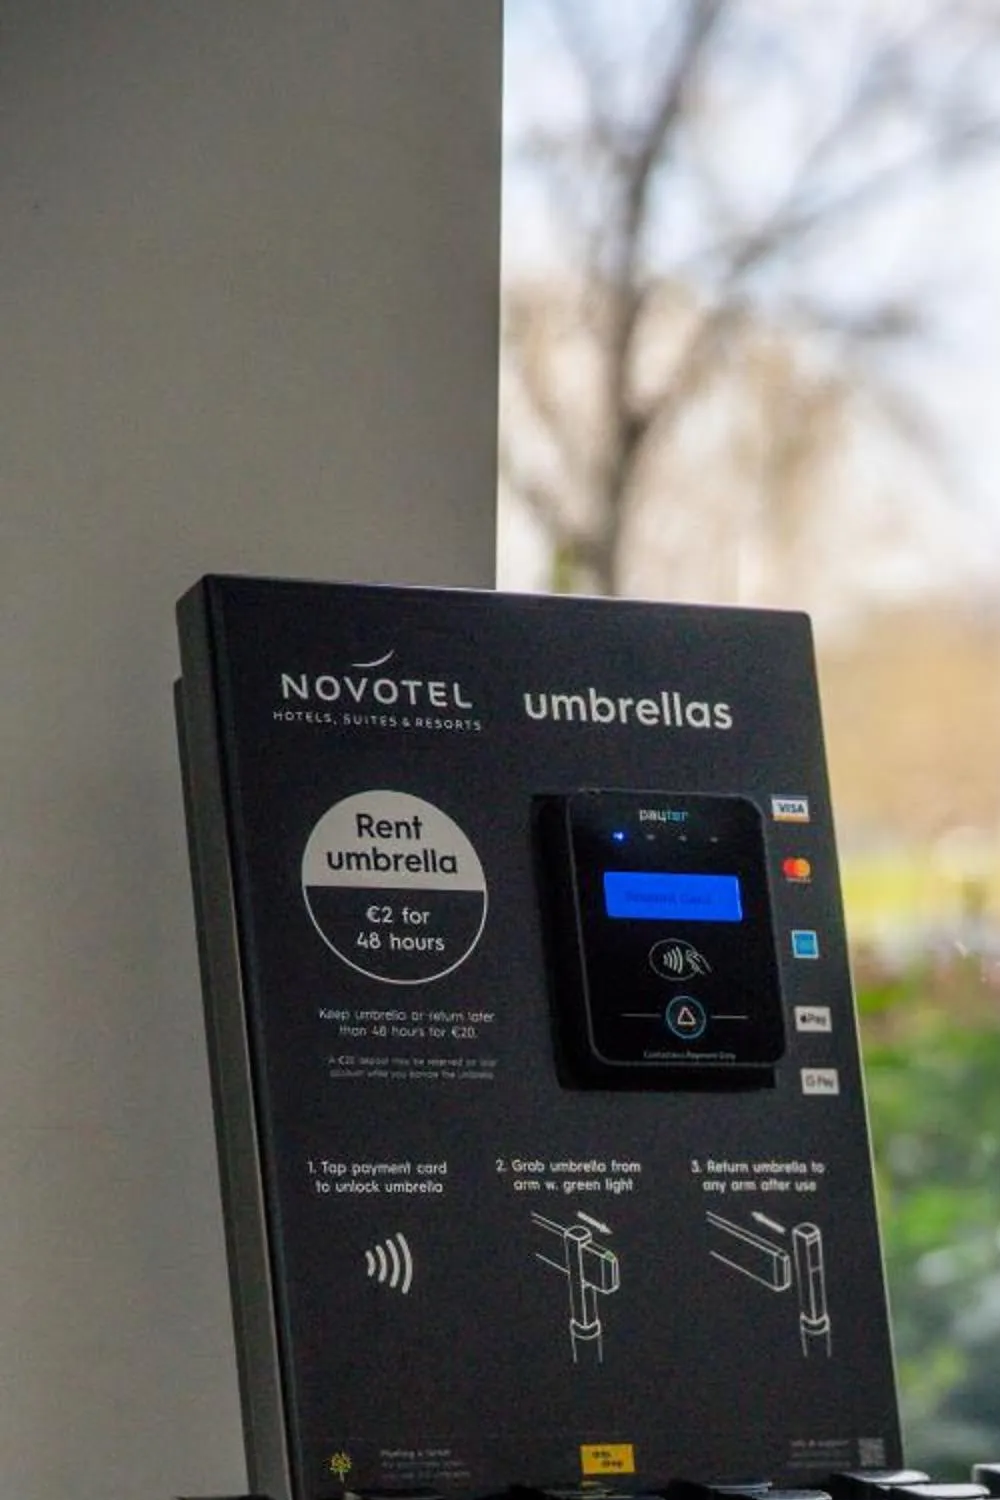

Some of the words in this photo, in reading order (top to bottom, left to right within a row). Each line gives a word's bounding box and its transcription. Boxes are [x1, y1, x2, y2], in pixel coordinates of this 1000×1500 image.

[281, 673, 473, 708] NOVOTEL
[524, 687, 733, 730] umbrellas
[273, 711, 337, 725] HOTELS,
[343, 714, 397, 727] SUITES
[402, 717, 411, 727] &
[415, 717, 482, 731] RESORTS
[778, 803, 804, 813] VISA
[356, 813, 422, 840] Rent
[327, 847, 458, 873] umbrella
[365, 905, 393, 924] €2
[402, 906, 431, 925] for
[356, 932, 381, 949] 48
[390, 933, 445, 951] hours
[319, 1008, 349, 1021] Keep
[355, 1009, 406, 1021] umbrella
[339, 1025, 367, 1037] than
[391, 1026, 425, 1038] hours
[428, 1027, 446, 1038] for
[306, 1161, 317, 1174] 1.
[321, 1161, 347, 1176] Tap
[352, 1161, 411, 1176] payment
[417, 1161, 447, 1174] card
[495, 1159, 507, 1172] 2.
[511, 1159, 545, 1172] Grab
[551, 1160, 606, 1172] umbrella
[611, 1160, 641, 1172] from
[707, 1160, 749, 1172] Return
[753, 1160, 807, 1172] umbrella
[811, 1161, 824, 1172] to
[315, 1180, 329, 1192] to
[335, 1180, 379, 1192] unlock
[385, 1180, 443, 1193] umbrella
[513, 1180, 540, 1191] arm
[563, 1180, 600, 1193] green
[605, 1178, 633, 1194] light
[703, 1181, 726, 1193] any
[731, 1182, 756, 1191] arm
[761, 1180, 790, 1191] after
[795, 1183, 816, 1192] use
